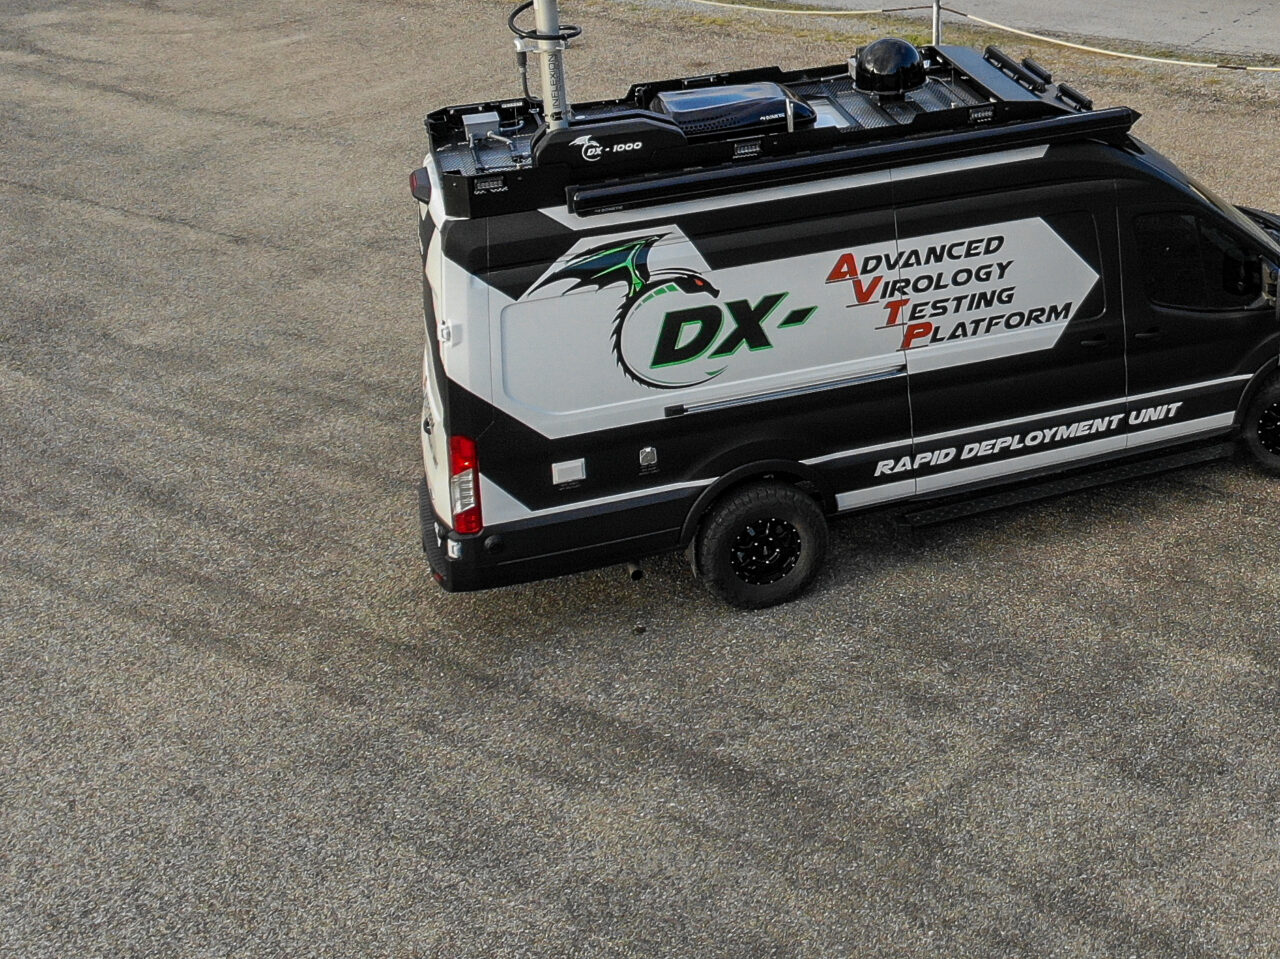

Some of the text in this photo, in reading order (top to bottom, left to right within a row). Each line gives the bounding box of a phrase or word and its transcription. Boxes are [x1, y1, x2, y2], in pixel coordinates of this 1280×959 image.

[586, 146, 603, 156] DX
[612, 141, 643, 153] 1000
[826, 235, 1005, 280] ADVANCED
[852, 260, 1014, 303] VIROLOGY
[884, 286, 1016, 326] TESTING
[903, 302, 1073, 349] PLATFORM
[873, 401, 1184, 477] RAPID DEPLOYMENT UNIT
